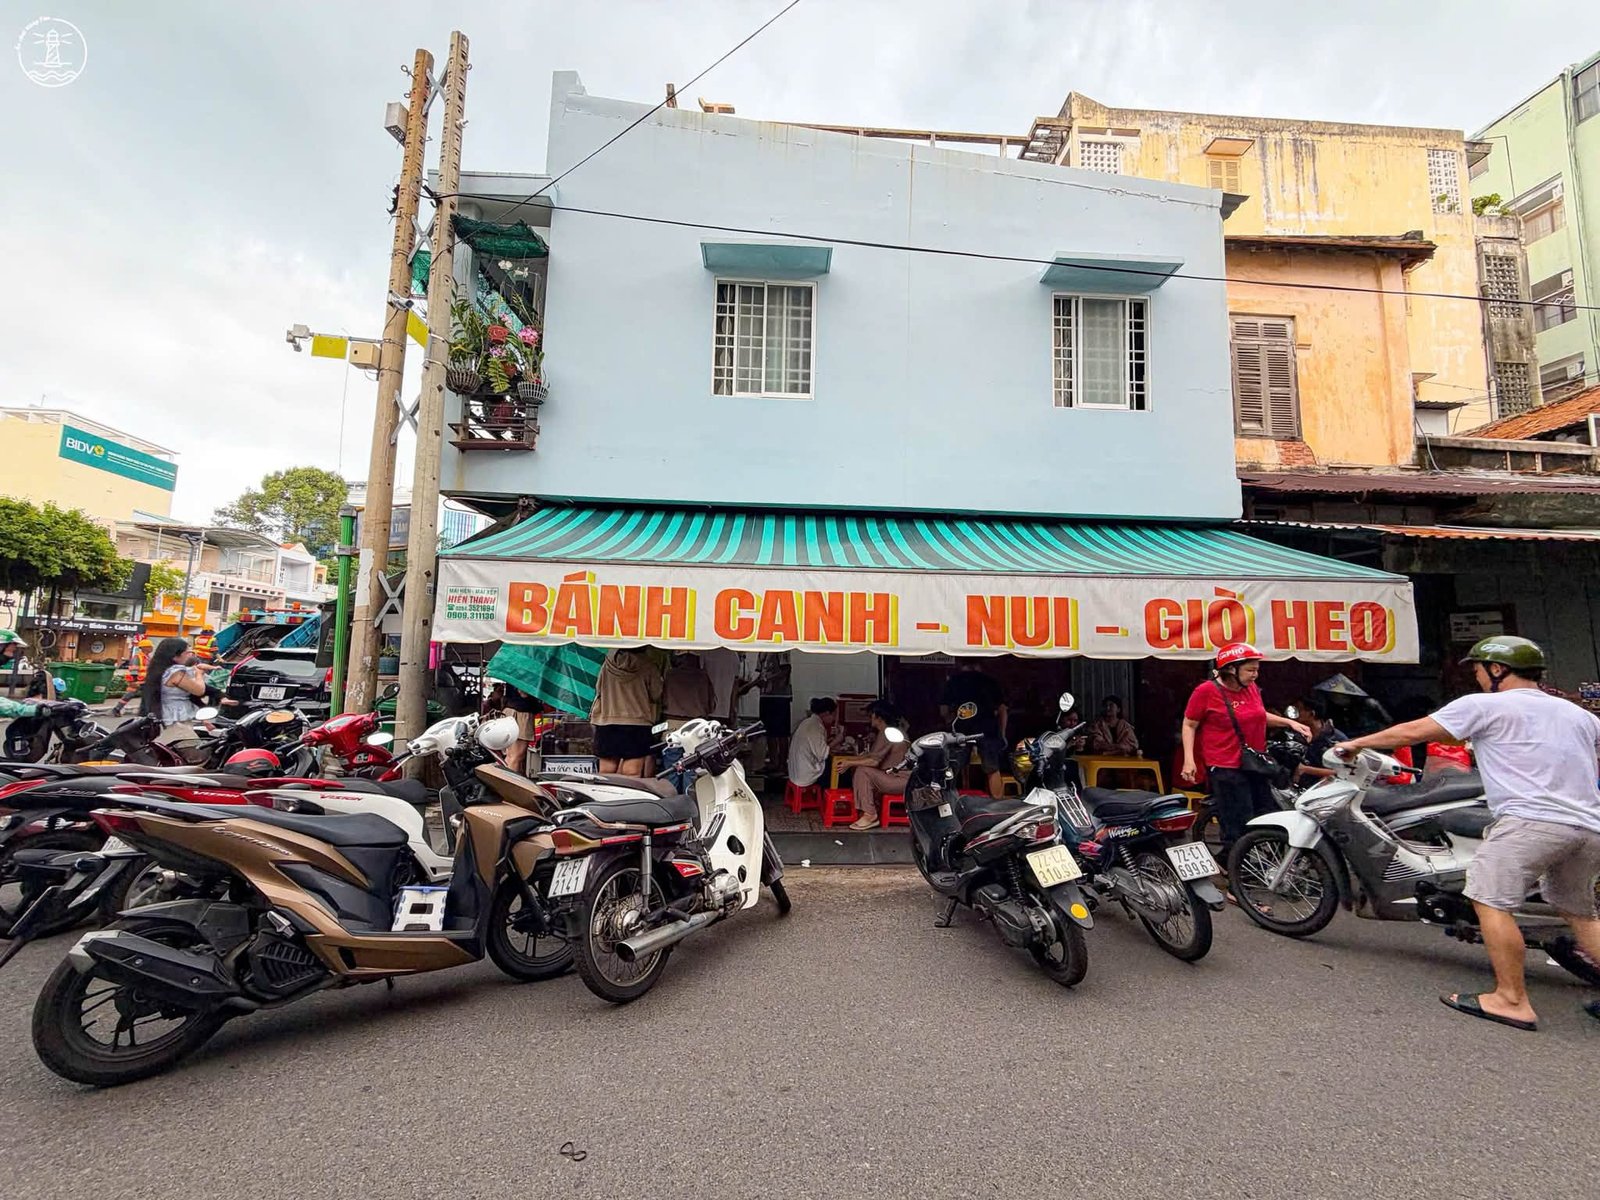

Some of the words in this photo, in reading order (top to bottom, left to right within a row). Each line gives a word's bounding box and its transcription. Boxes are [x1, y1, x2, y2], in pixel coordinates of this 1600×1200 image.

[65, 437, 95, 455] BIDV
[506, 571, 696, 641] BÁNH
[714, 588, 898, 646] CANH
[966, 595, 1079, 650] NUI
[1145, 587, 1256, 651] GIÒ
[1271, 600, 1397, 654] HEO
[1174, 846, 1205, 863] 72-C1
[1178, 860, 1216, 878] 699.63
[553, 876, 579, 895] 2141
